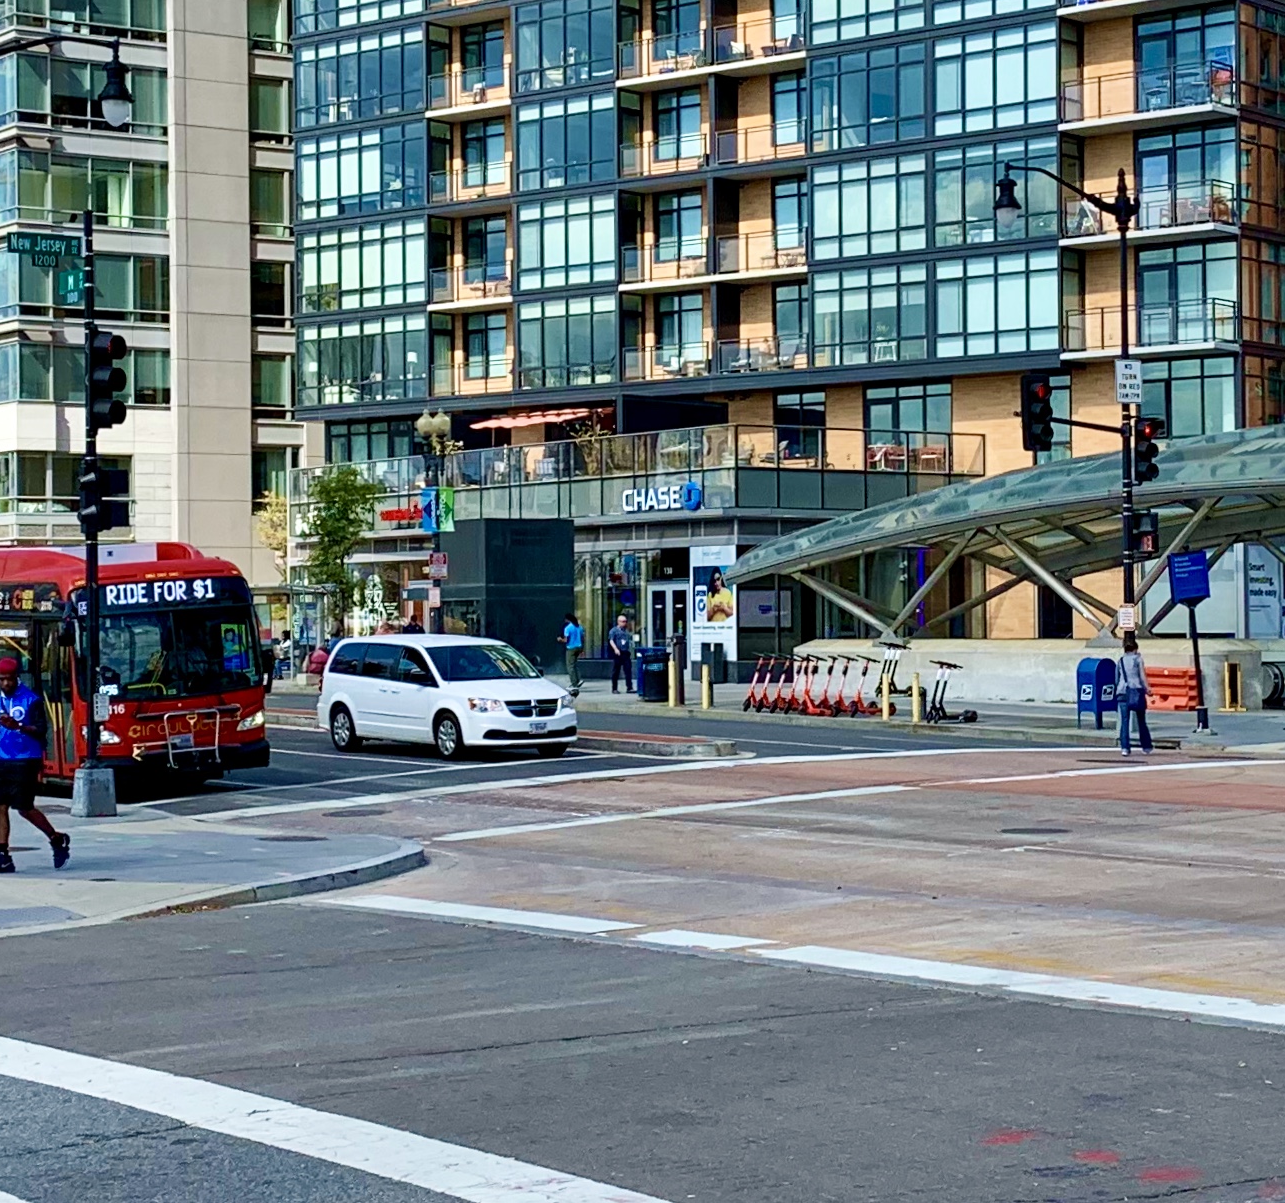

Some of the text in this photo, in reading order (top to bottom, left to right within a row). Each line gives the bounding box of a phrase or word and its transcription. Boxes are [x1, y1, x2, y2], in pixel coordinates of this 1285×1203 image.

[10, 234, 67, 256] New Jersey
[34, 254, 56, 267] 1200
[67, 275, 74, 290] M
[1118, 382, 1140, 391] ON RED
[622, 485, 682, 512] CHASE
[1248, 563, 1266, 571] Smart
[106, 578, 215, 606] RIDE FOR $1
[1249, 588, 1277, 598] made easy
